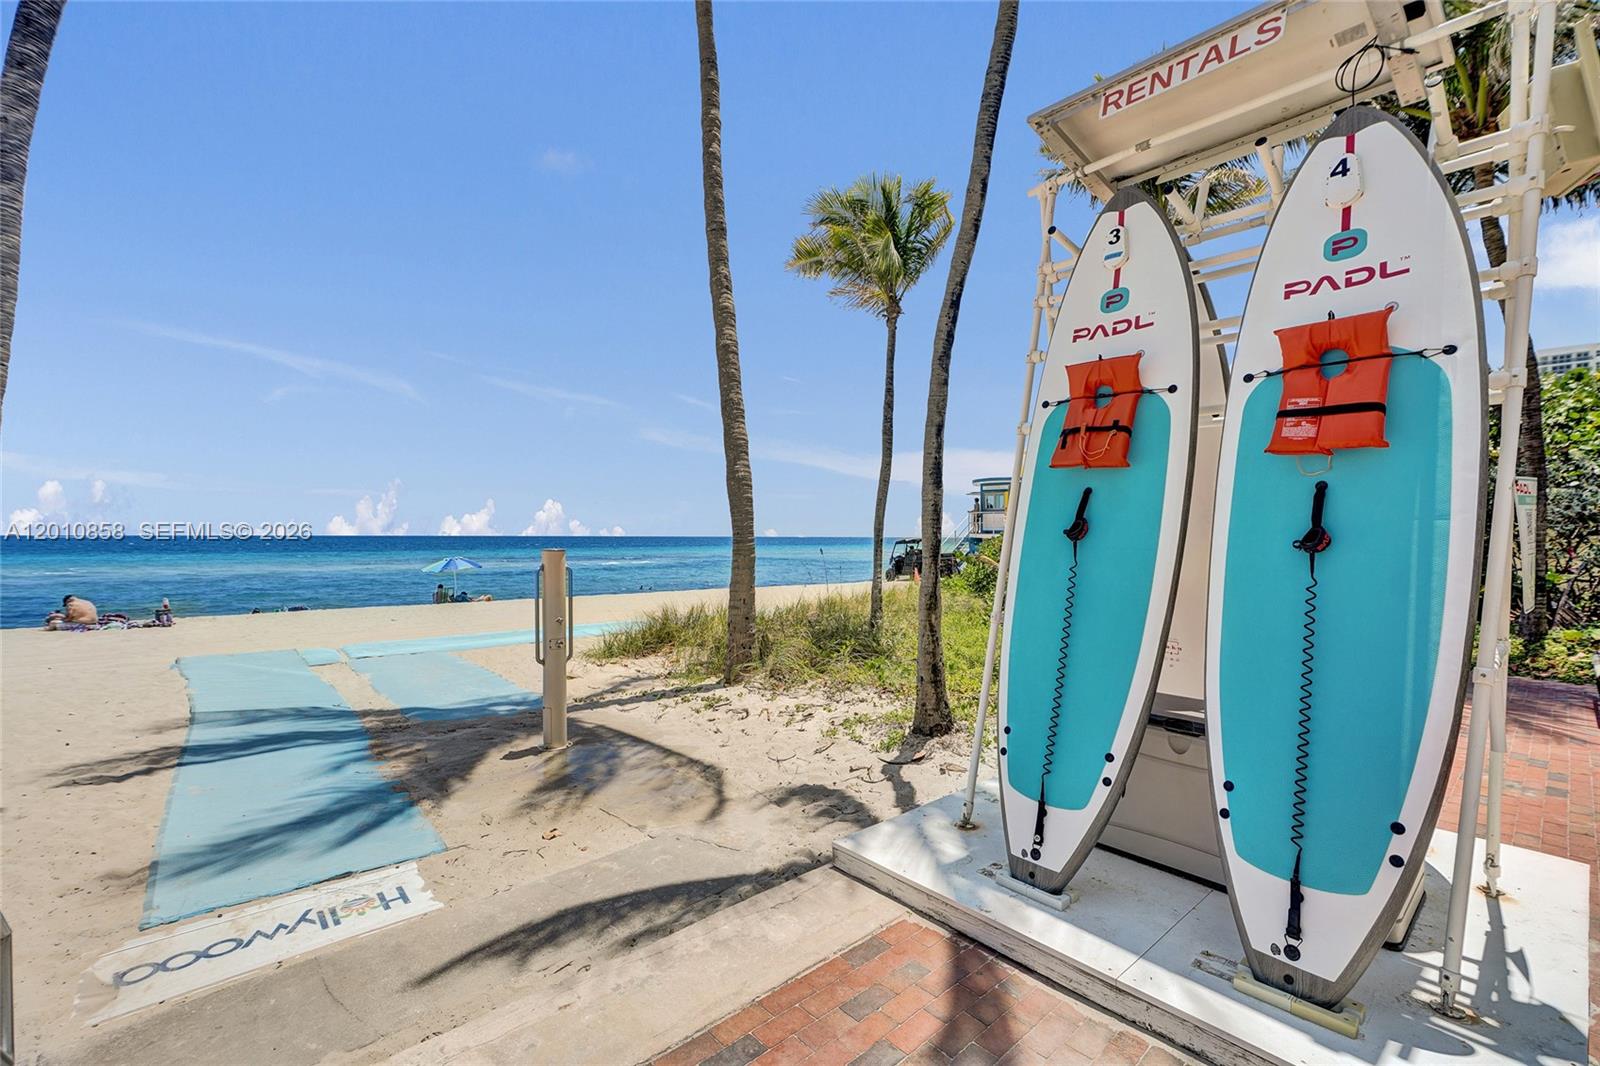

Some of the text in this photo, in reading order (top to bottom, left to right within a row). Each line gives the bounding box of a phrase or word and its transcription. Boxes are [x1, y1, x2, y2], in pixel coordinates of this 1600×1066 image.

[1101, 16, 1283, 117] RENTALS
[1330, 157, 1351, 178] 4
[1108, 228, 1121, 245] 3
[1331, 236, 1359, 256] P
[1283, 261, 1410, 300] PADL
[1105, 293, 1124, 309] P
[1072, 315, 1155, 343] PADL
